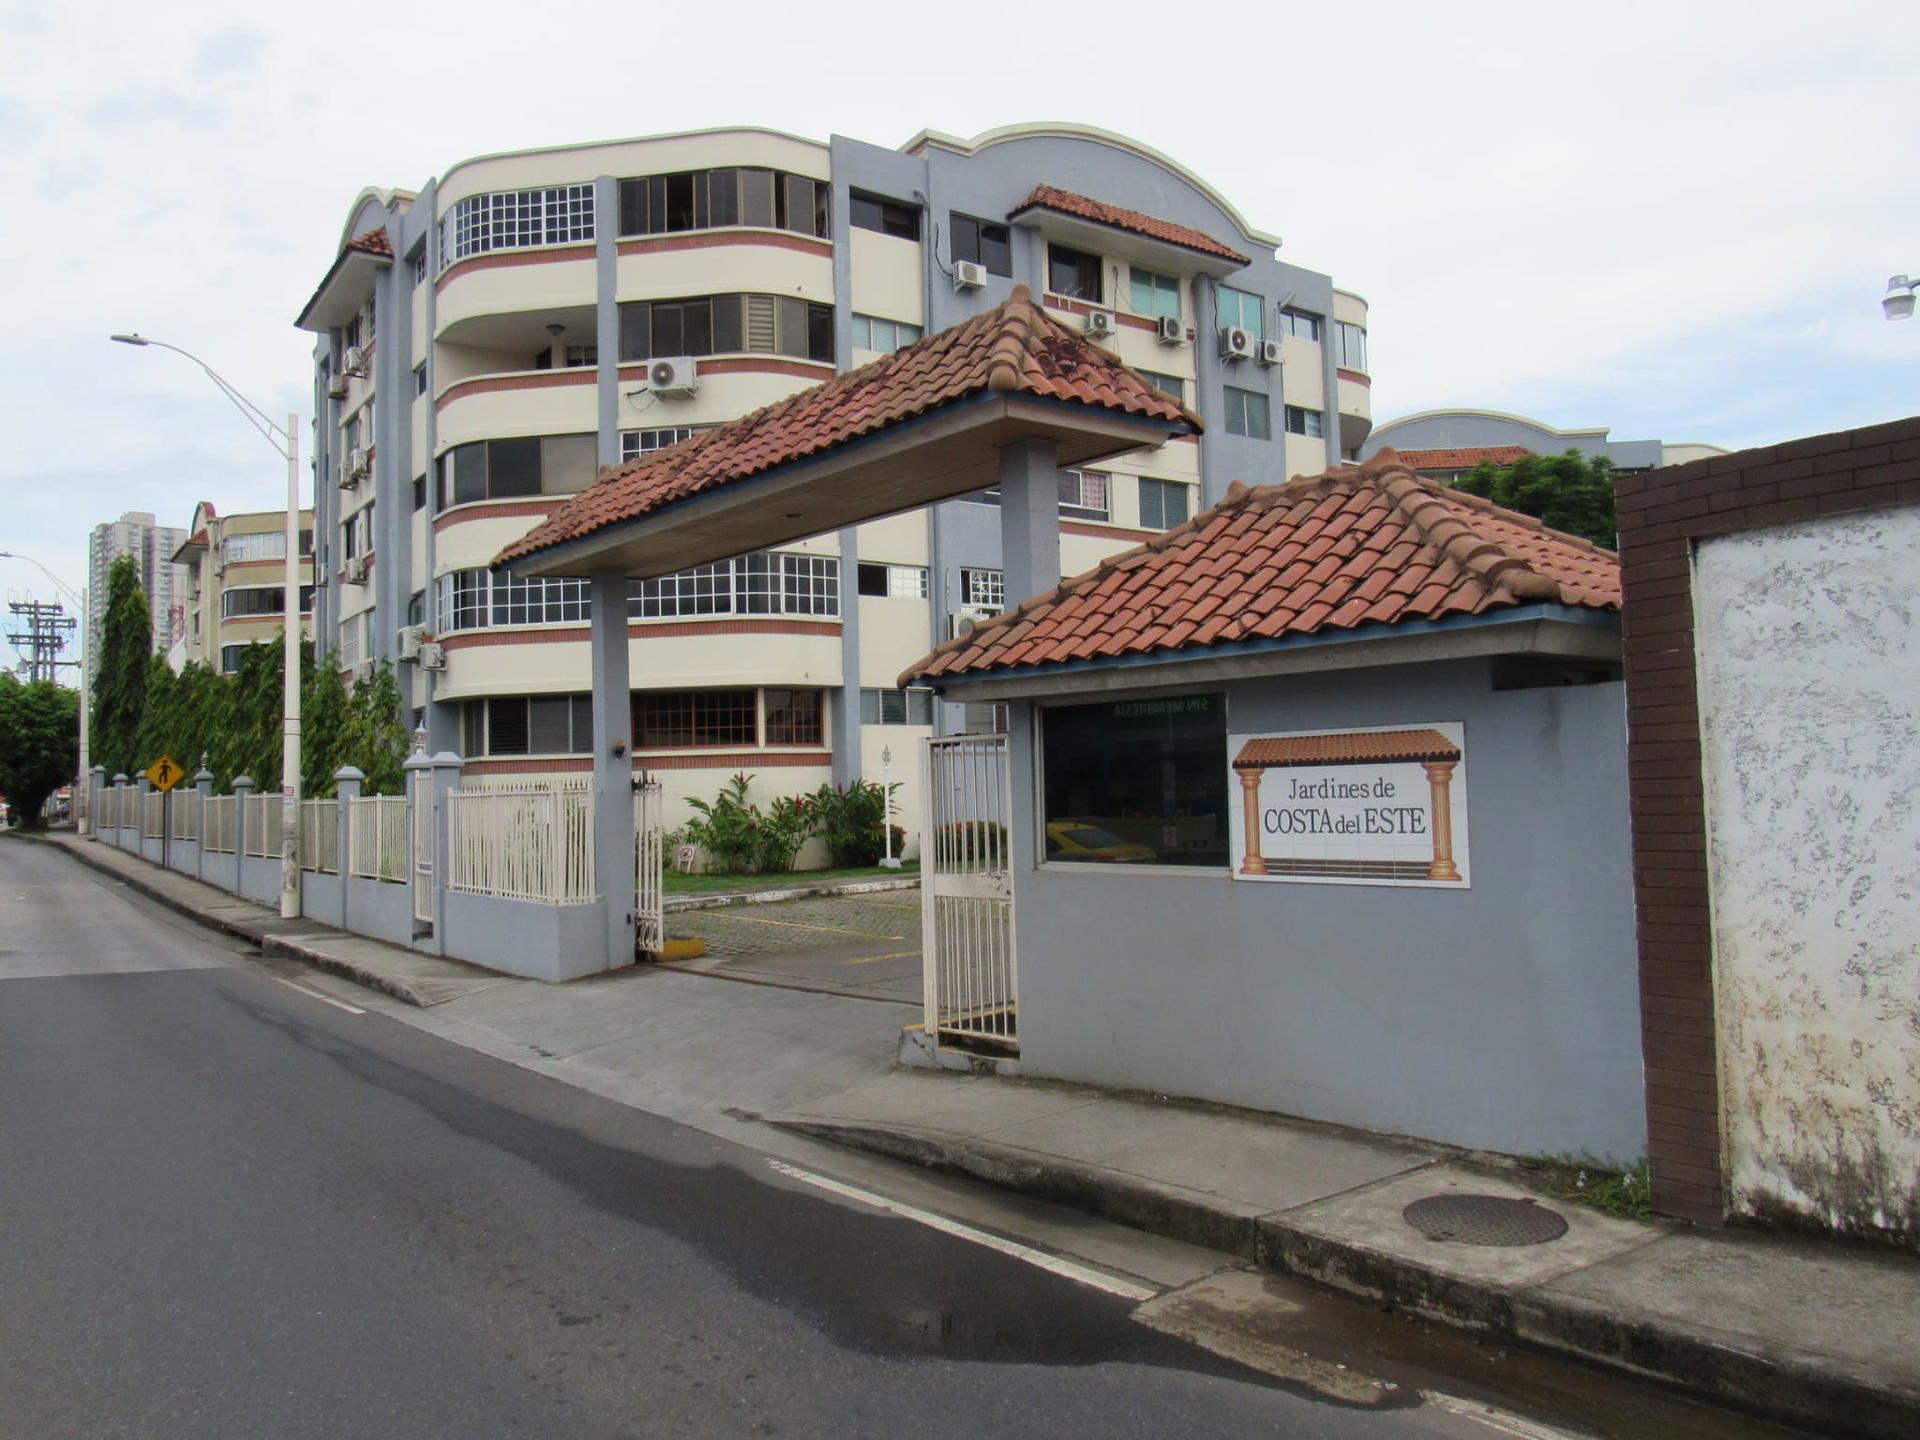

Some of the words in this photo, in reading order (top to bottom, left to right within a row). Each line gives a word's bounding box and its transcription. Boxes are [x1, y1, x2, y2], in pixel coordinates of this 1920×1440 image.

[1289, 778, 1370, 799] Jardines
[1373, 777, 1395, 798] de
[1264, 808, 1334, 834] COSTA
[1335, 815, 1361, 834] del
[1364, 807, 1426, 834] ESTE
